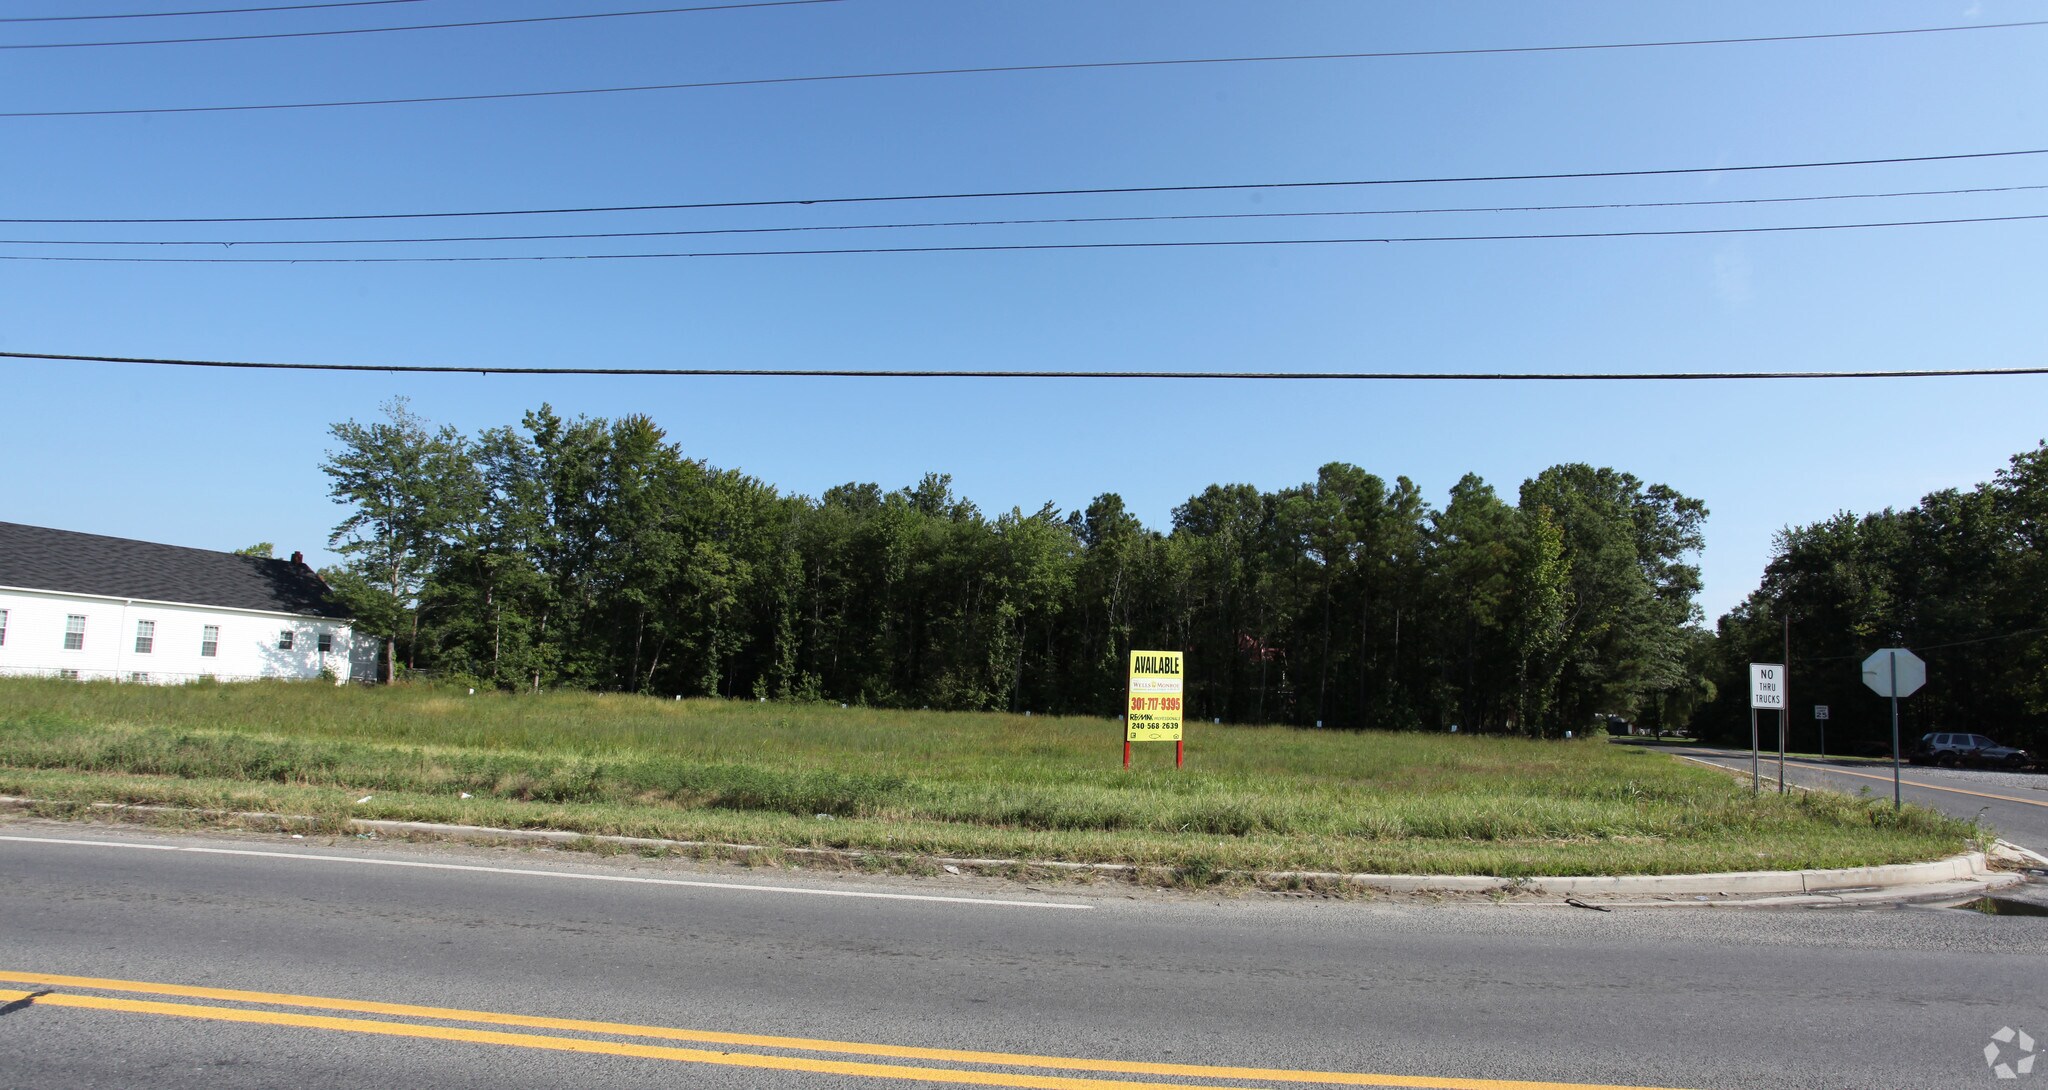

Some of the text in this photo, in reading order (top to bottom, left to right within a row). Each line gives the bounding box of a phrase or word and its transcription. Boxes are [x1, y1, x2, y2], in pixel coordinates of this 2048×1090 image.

[1134, 656, 1180, 674] AVAILABLE
[1760, 669, 1774, 680] NO
[1759, 682, 1776, 692] THRU
[1131, 697, 1180, 711] 301-717-9395
[1755, 694, 1780, 704] TRUCKS
[1131, 722, 1179, 730] 240 568 2639
